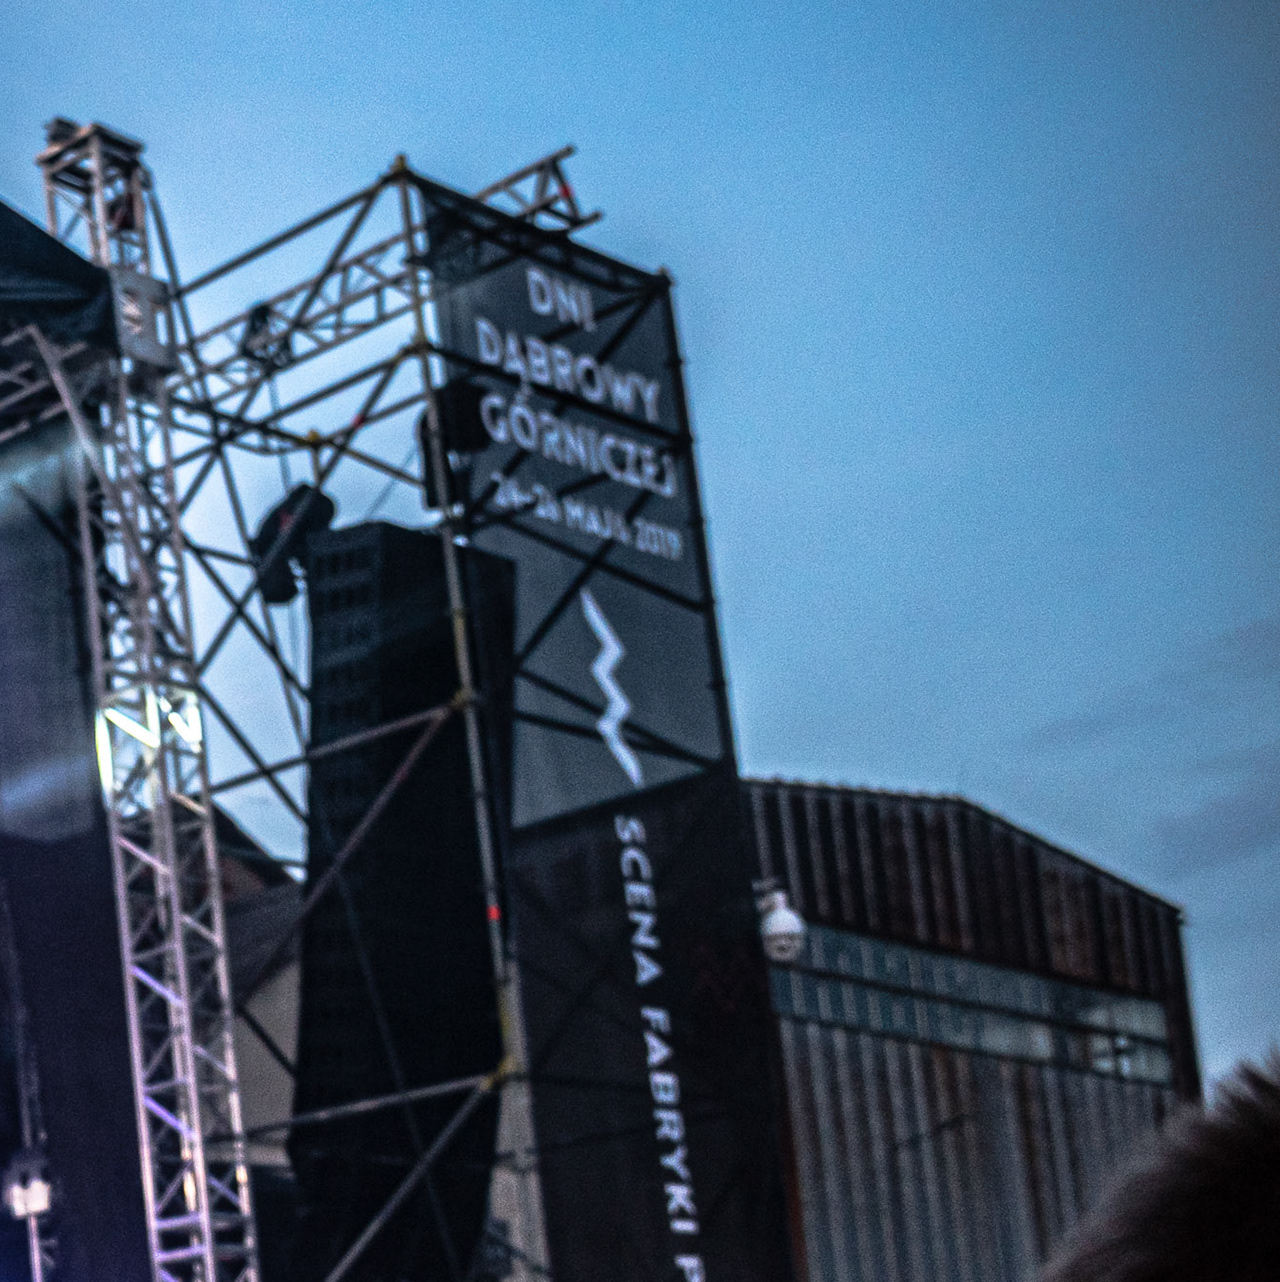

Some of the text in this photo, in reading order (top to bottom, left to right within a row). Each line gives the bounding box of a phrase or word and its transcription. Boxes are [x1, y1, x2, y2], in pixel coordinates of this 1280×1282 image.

[526, 267, 597, 332] DNI
[475, 315, 659, 423] DĄBROWY
[480, 391, 676, 497] GÓRNICZEJ
[614, 814, 663, 987] SCENA
[640, 1005, 699, 1235] FABRYKI
